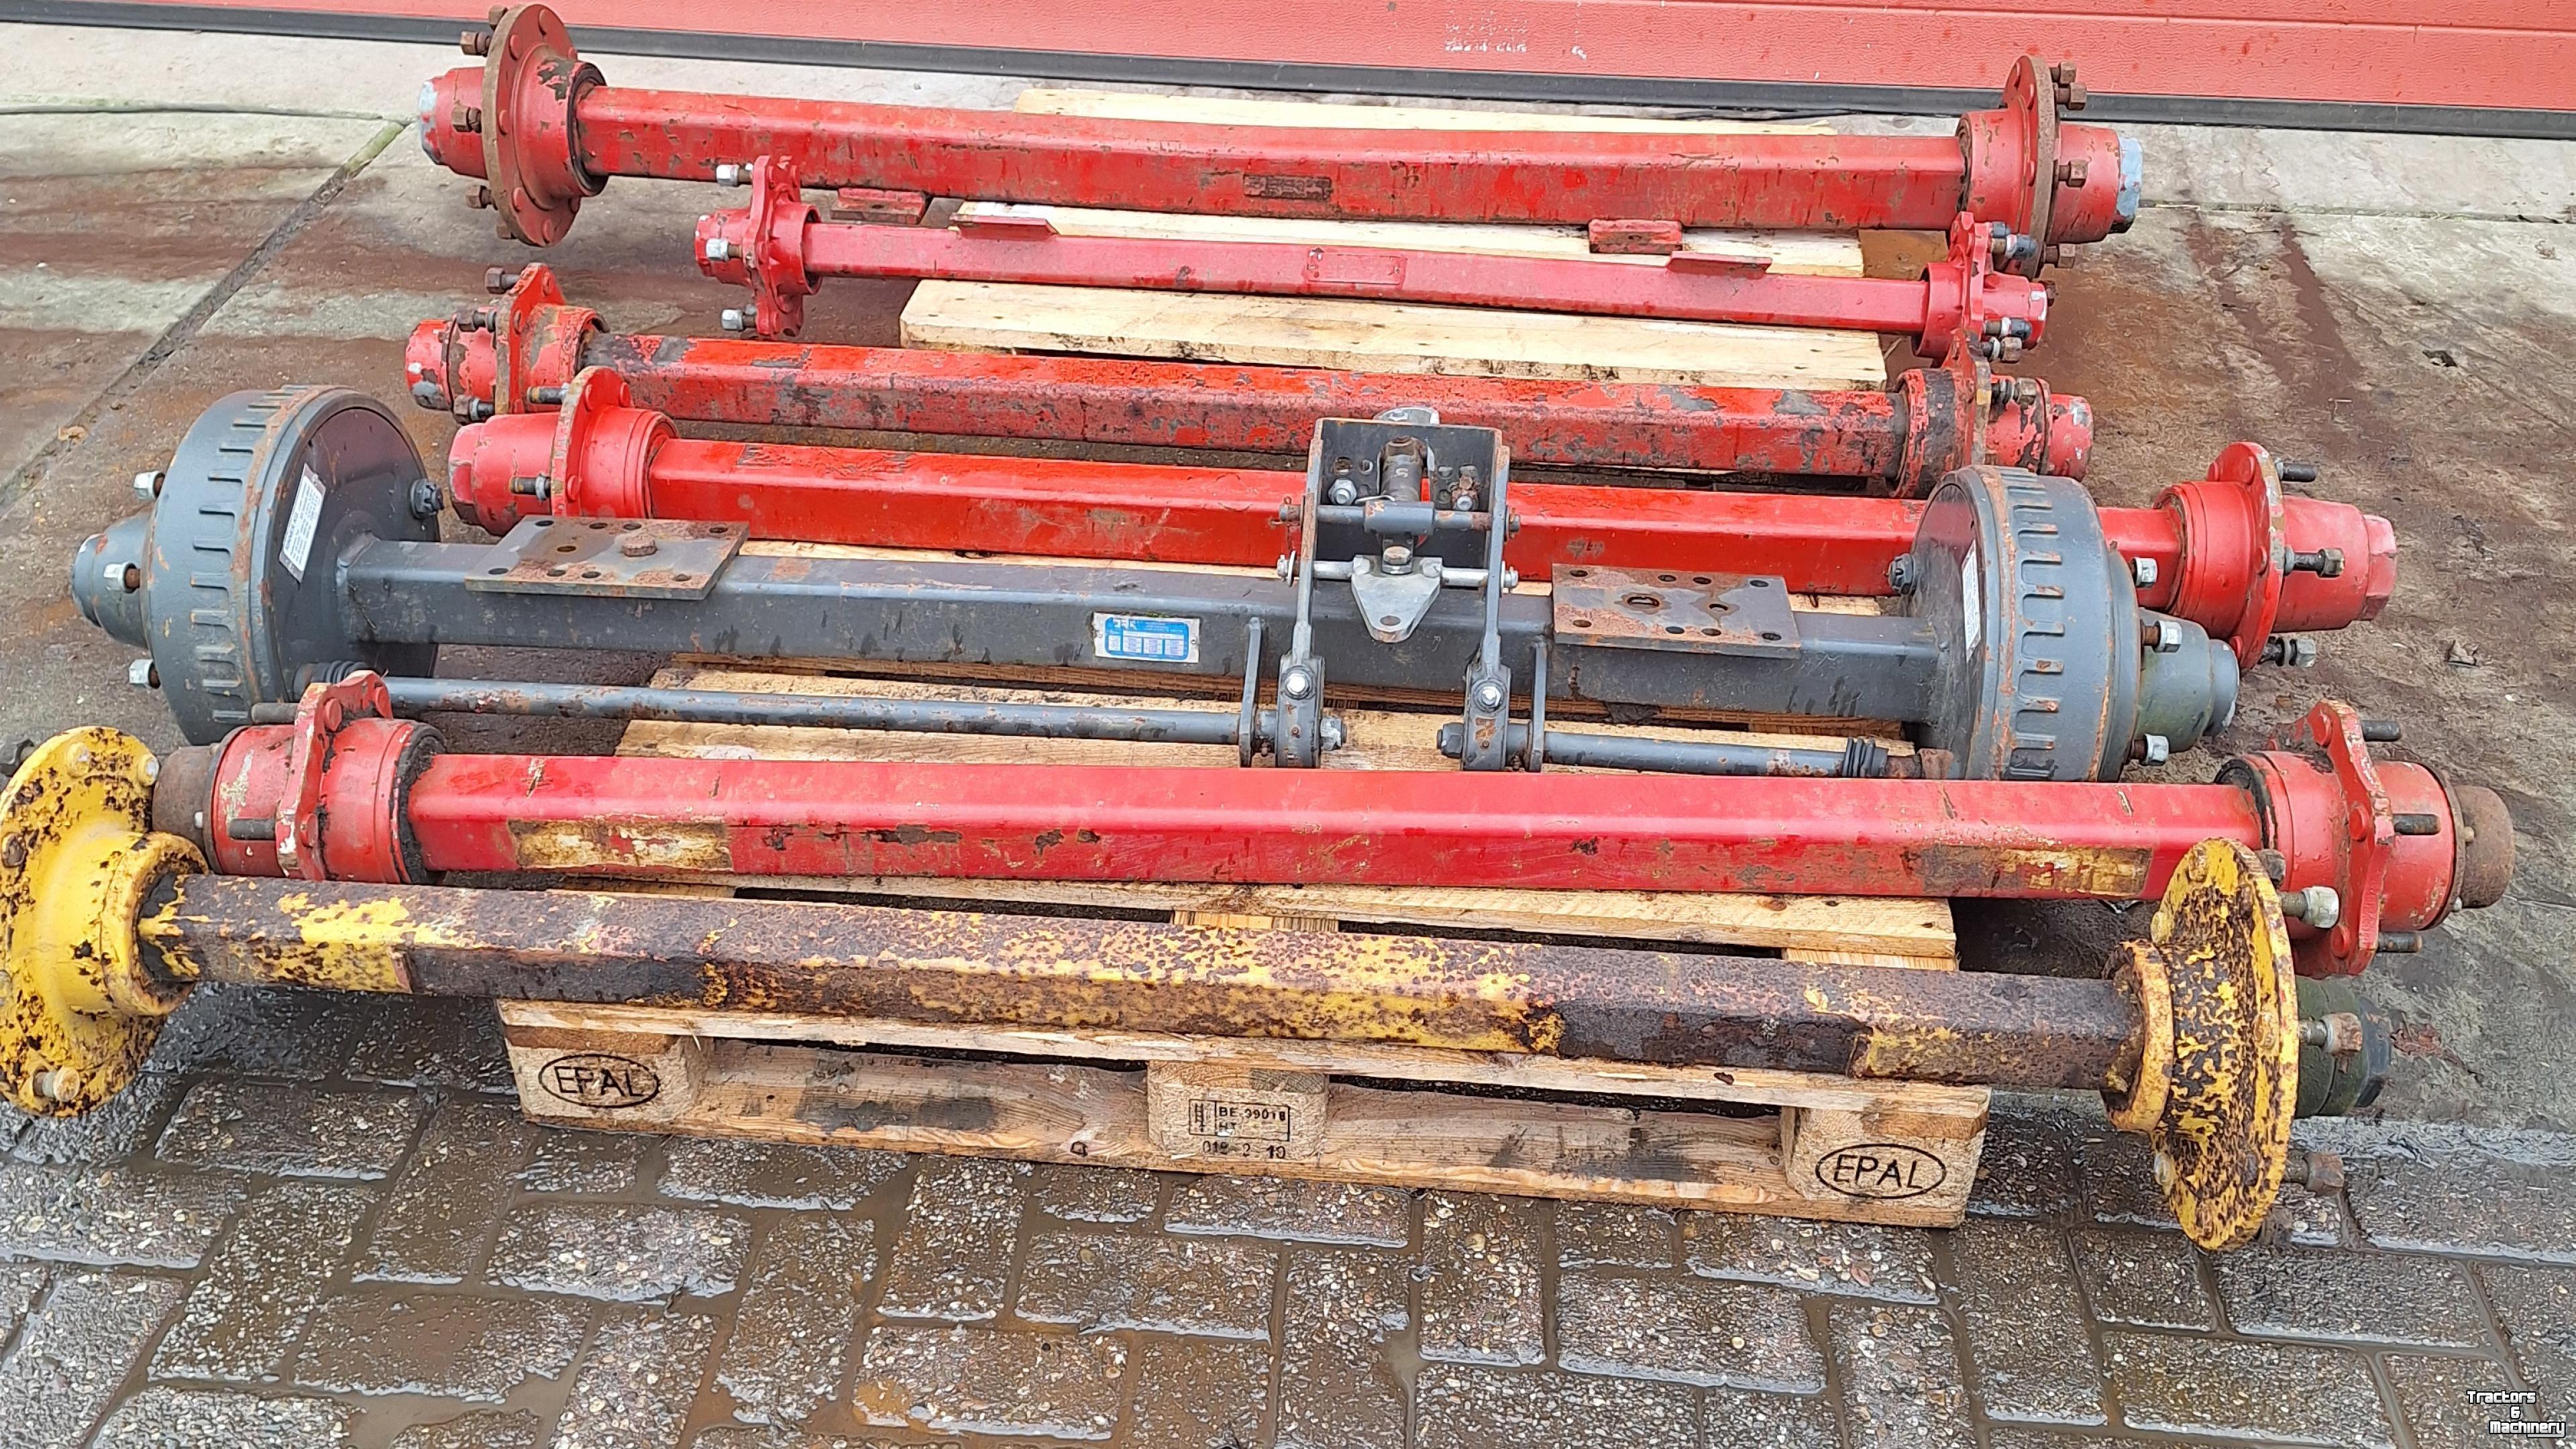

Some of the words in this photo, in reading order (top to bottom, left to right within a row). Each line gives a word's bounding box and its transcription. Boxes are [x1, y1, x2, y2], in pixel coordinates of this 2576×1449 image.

[554, 1065, 645, 1097] EPAL
[1218, 1106, 1238, 1118] BE
[1832, 1154, 1923, 1189] EPAL
